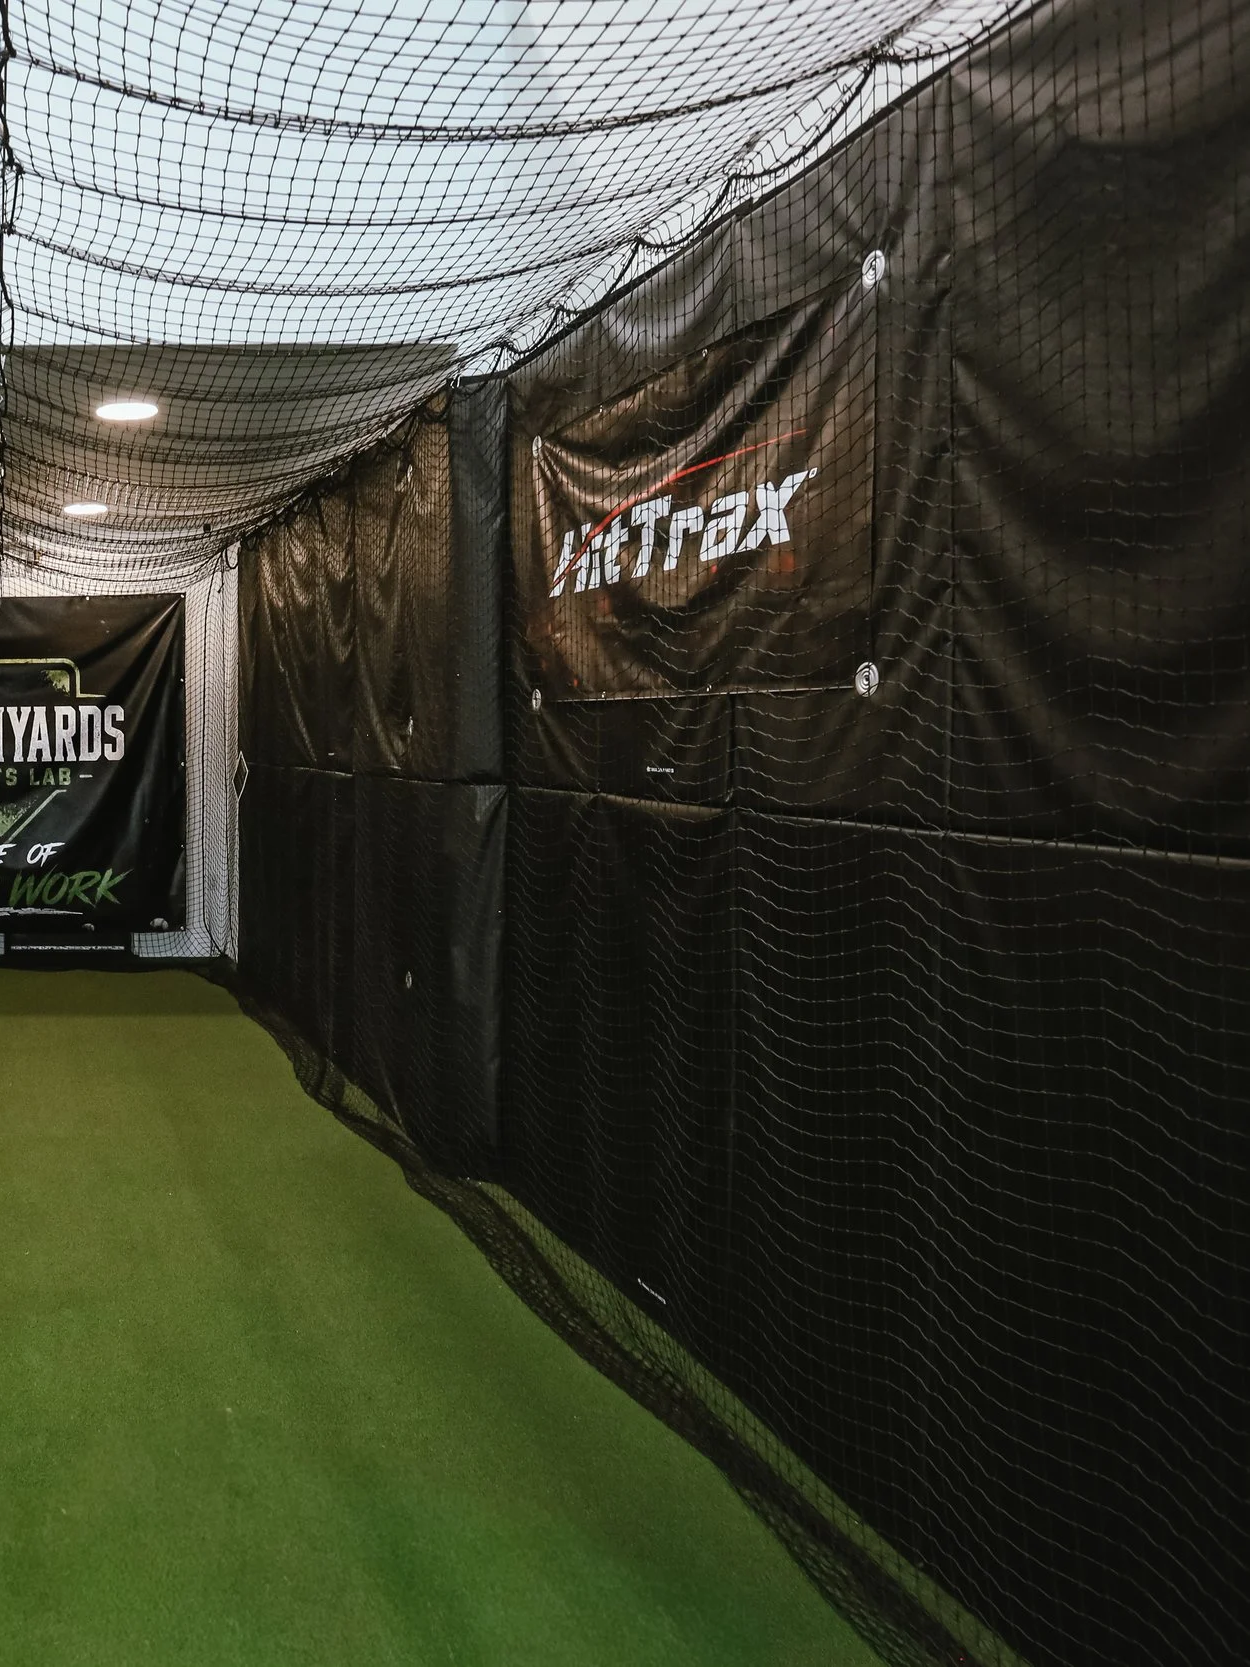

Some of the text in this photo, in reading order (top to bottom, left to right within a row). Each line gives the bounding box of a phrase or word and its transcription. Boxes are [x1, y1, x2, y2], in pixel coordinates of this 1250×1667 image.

[29, 767, 72, 786] LAB
[26, 842, 65, 867] OF
[9, 865, 134, 907] WORK
